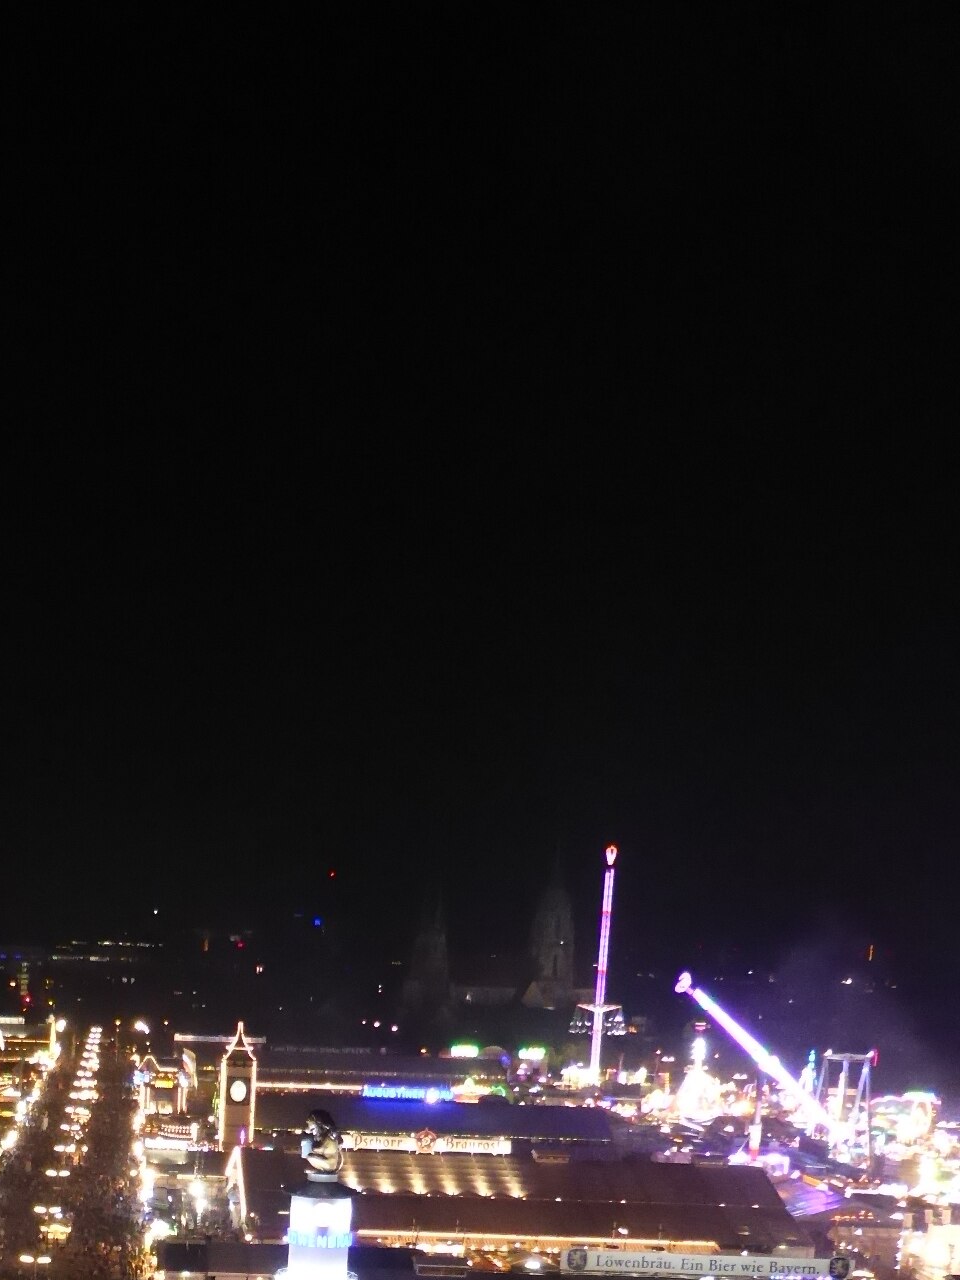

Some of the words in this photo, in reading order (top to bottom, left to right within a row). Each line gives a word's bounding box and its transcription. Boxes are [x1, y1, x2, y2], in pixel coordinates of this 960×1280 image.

[596, 1254, 675, 1270] Löwenbräu.
[680, 1257, 704, 1271] Ein
[709, 1259, 737, 1272] Bier
[741, 1260, 764, 1273] wie
[768, 1261, 821, 1277] Bayern.
